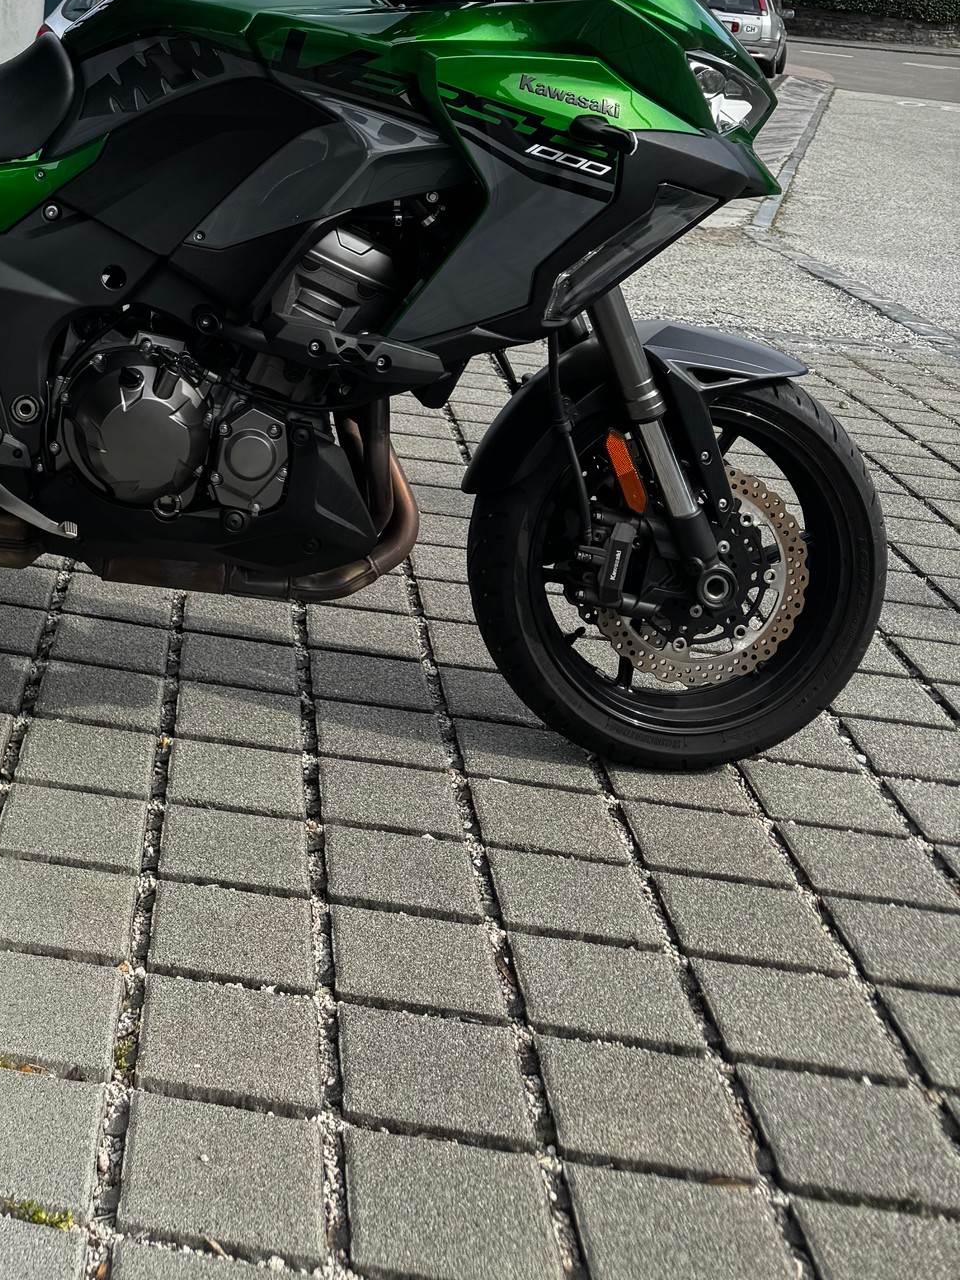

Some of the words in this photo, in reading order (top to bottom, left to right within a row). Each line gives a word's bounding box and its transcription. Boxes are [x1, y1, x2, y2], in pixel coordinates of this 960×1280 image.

[745, 25, 756, 33] CH
[519, 73, 621, 119] Kawasaki
[524, 143, 612, 176] 1000
